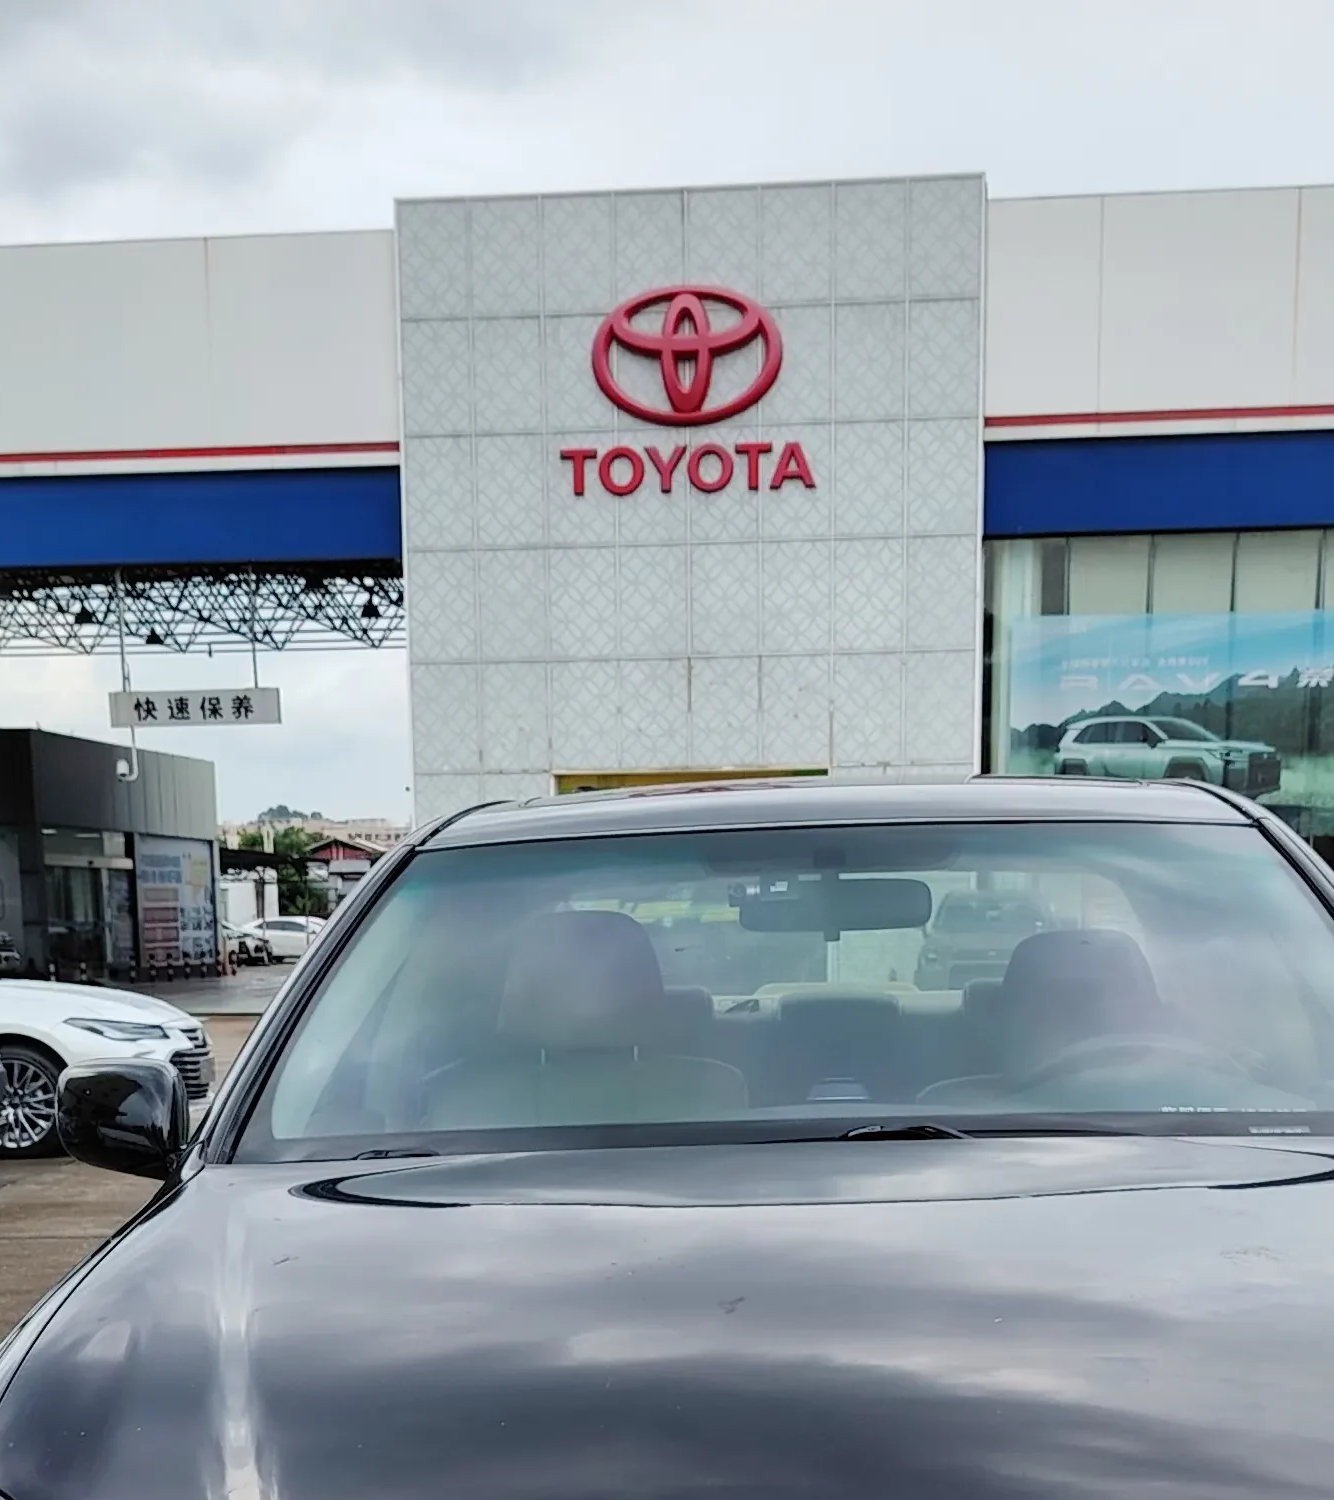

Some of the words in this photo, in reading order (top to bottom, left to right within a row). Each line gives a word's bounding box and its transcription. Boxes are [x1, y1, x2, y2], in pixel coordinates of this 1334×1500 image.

[560, 442, 816, 496] TOYOTA
[133, 694, 254, 722] 快速保养
